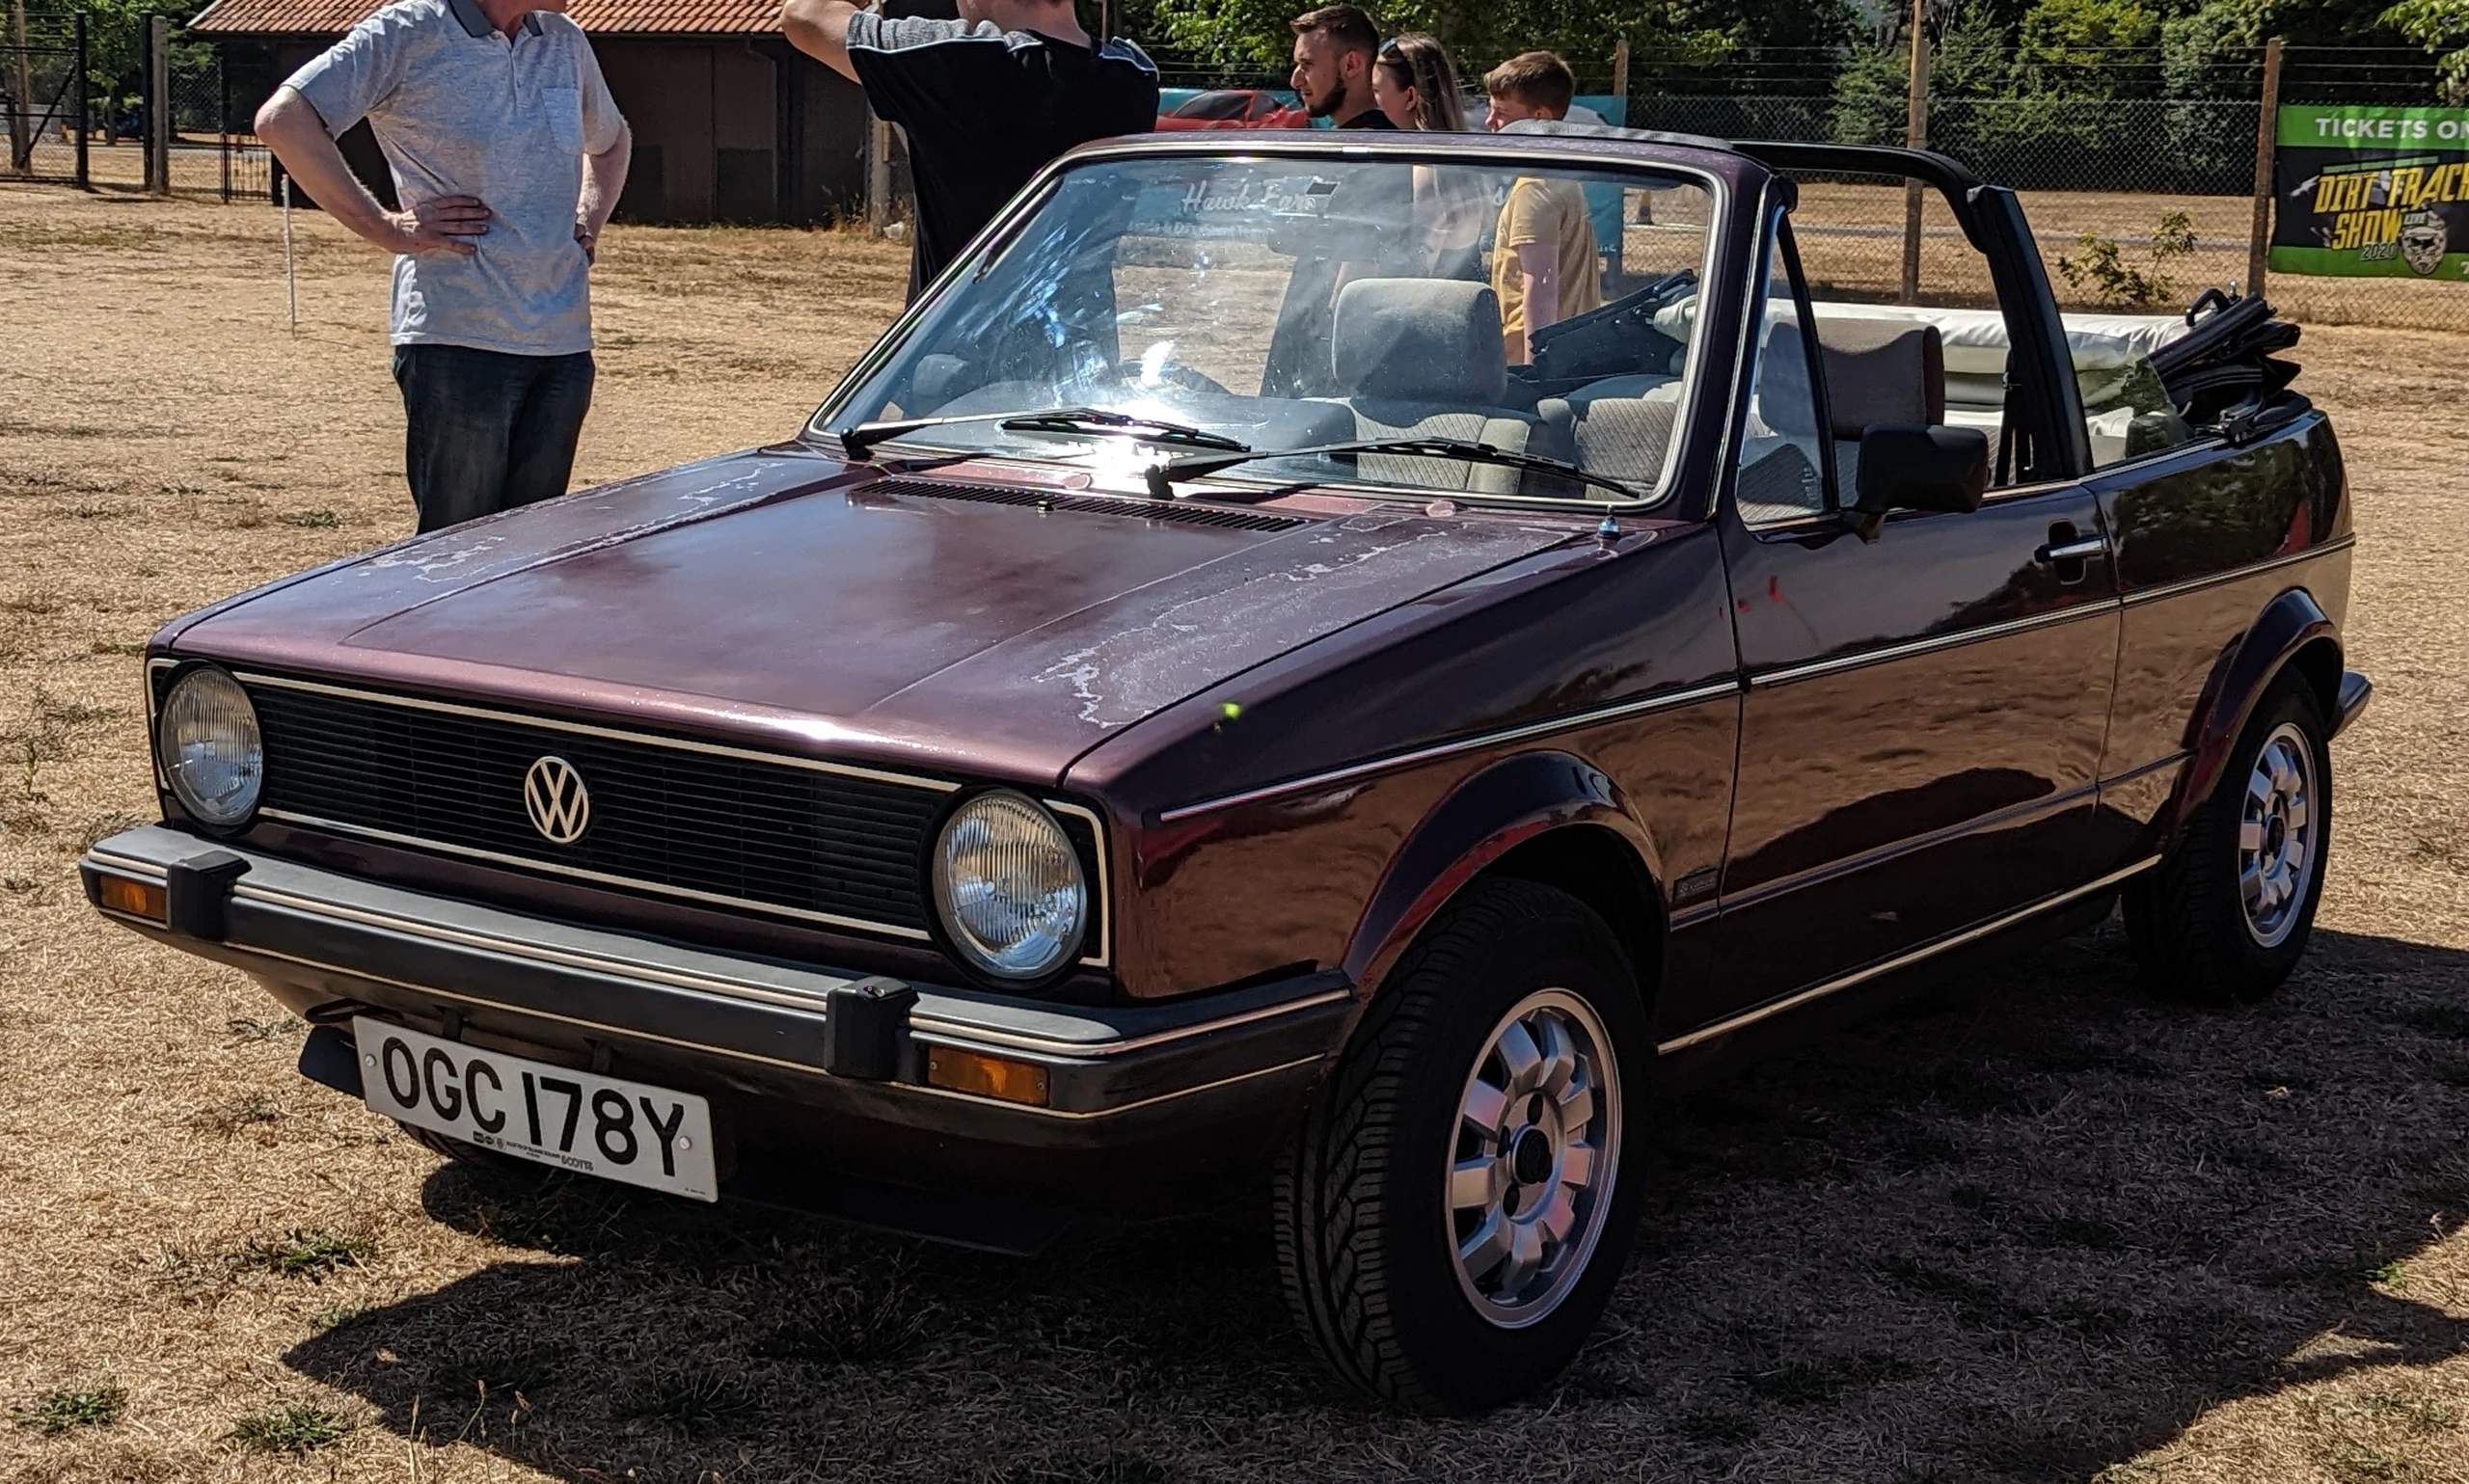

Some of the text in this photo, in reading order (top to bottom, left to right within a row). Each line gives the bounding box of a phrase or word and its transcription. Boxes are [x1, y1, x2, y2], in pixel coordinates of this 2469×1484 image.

[2315, 117, 2428, 140] TICKETS
[1181, 180, 1252, 213] Hawk
[2313, 170, 2381, 214] DIRT
[2330, 207, 2403, 251] SHOW
[2360, 243, 2399, 262] 2020
[382, 1036, 685, 1178] OGC 178Y
